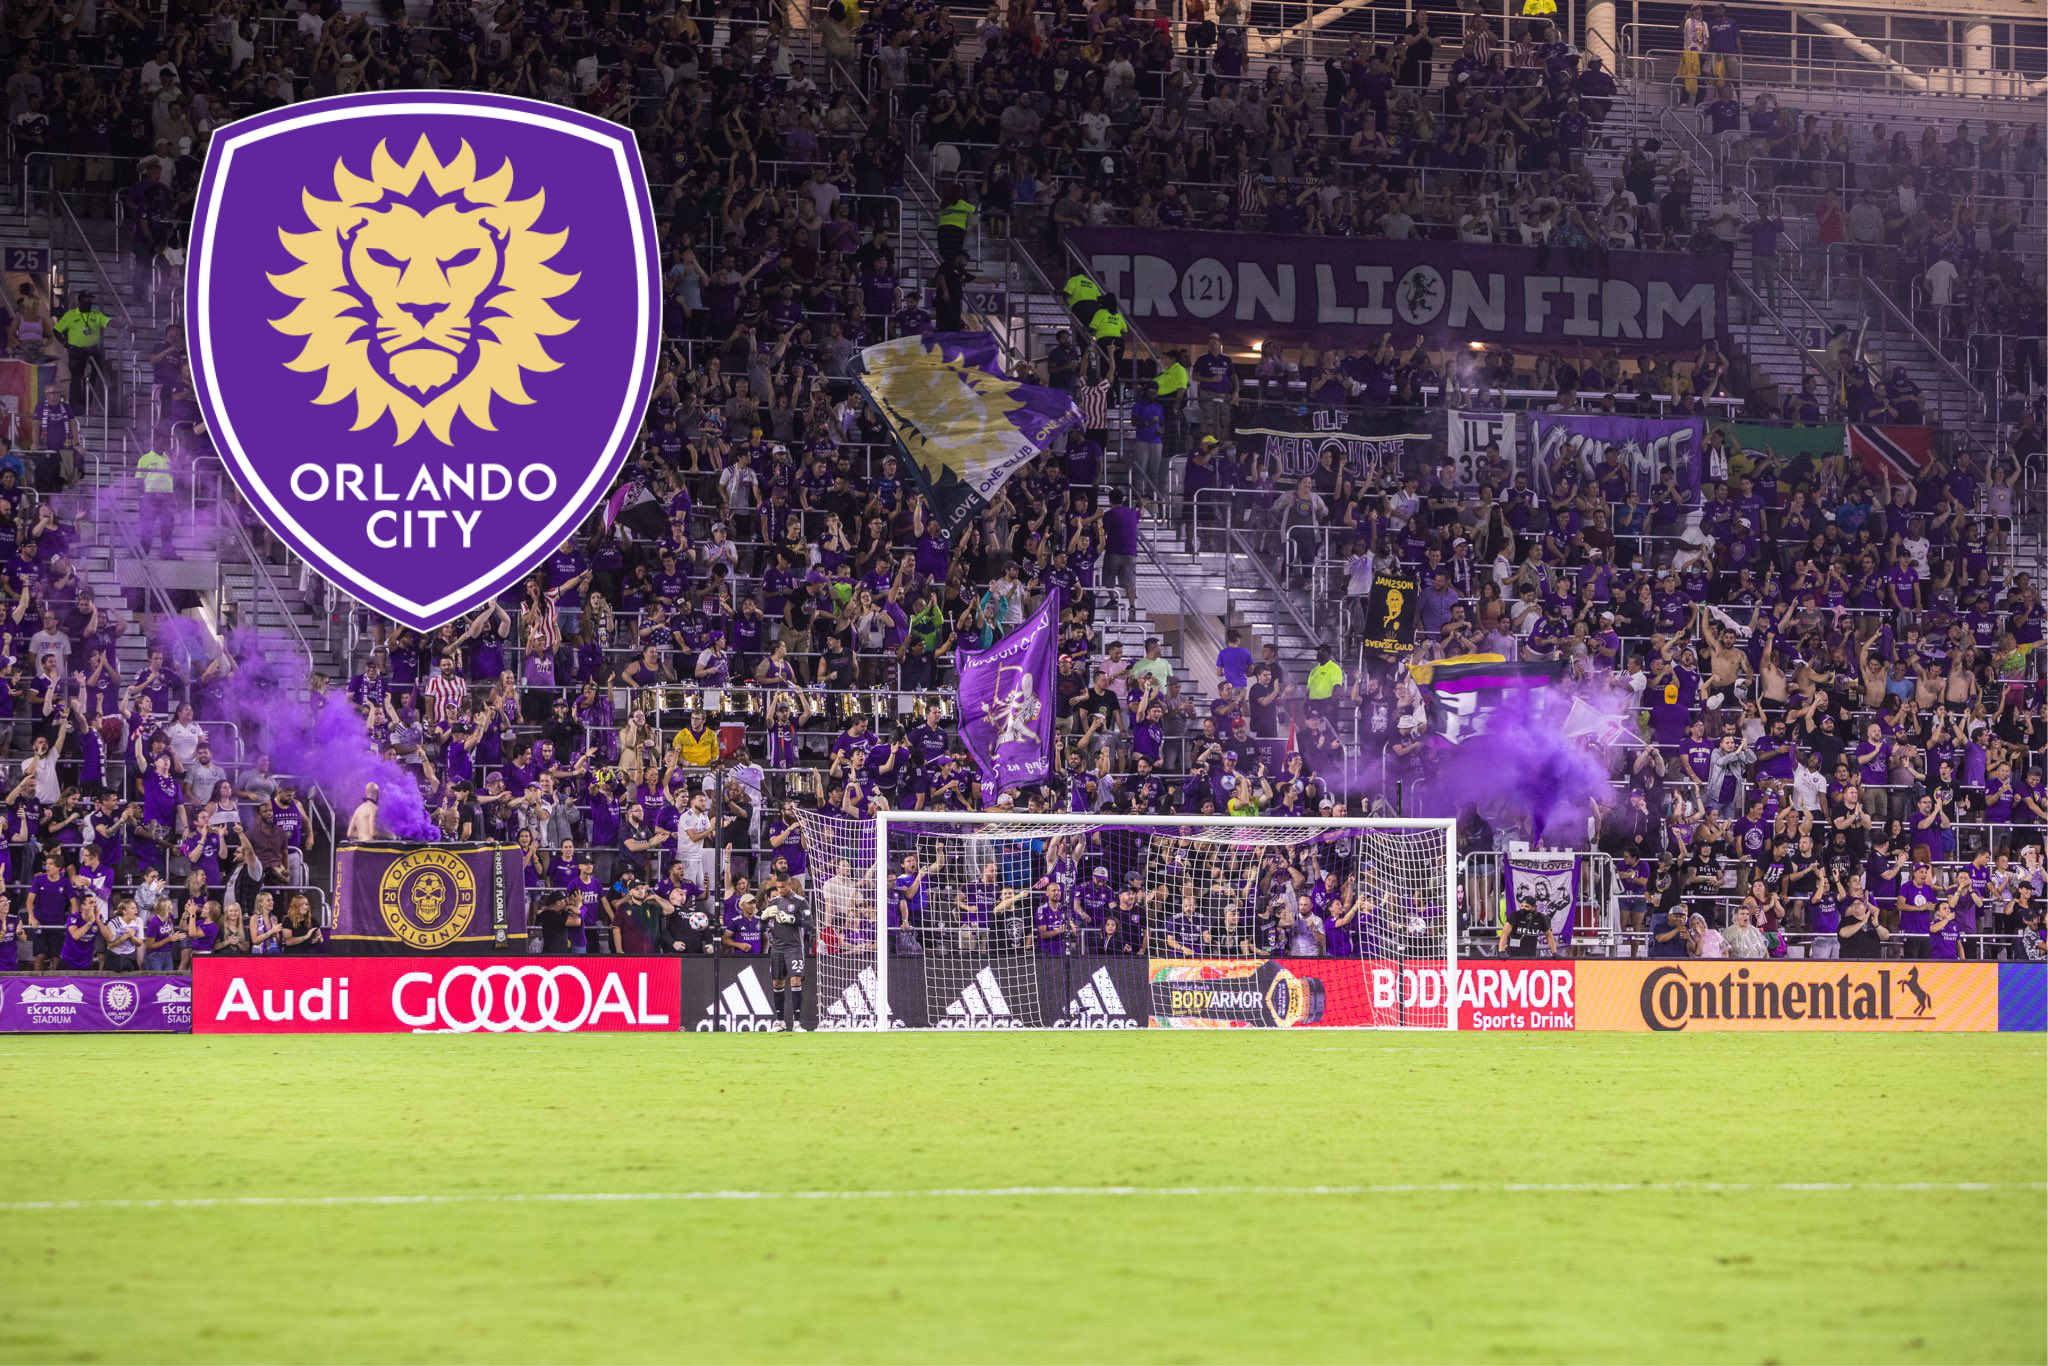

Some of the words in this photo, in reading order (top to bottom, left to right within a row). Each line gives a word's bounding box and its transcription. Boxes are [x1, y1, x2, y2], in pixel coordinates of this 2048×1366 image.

[14, 250, 38, 270] 25
[1091, 254, 1295, 323] IRON
[1315, 264, 1506, 332] LION
[1523, 275, 1716, 340] FIRM
[1187, 273, 1226, 303] 121
[975, 294, 997, 313] 26
[1036, 419, 1059, 442] ONE
[1312, 410, 1349, 431] ILF
[1463, 420, 1503, 452] ILF
[980, 468, 1004, 493] ONE
[1003, 445, 1033, 469] CLUB
[950, 493, 980, 525] LOVE
[1364, 639, 1393, 649] SVENSK
[1394, 643, 1414, 652] GULD
[393, 853, 465, 880] ORLANDO
[1509, 860, 1539, 869] JESUS
[1541, 862, 1573, 870] LOVES
[495, 876, 503, 888] OF
[384, 892, 396, 901] 20
[461, 892, 471, 901] 10
[496, 889, 504, 923] FLORIDA
[391, 913, 467, 944] ORIGINAL
[791, 960, 804, 970] 23
[215, 977, 348, 1021] Audi
[392, 965, 669, 1032] GOOOOAL
[1172, 991, 1263, 1009] BODYARMOR
[1639, 964, 1893, 1032] Continental
[27, 1004, 76, 1015] EXPLORIA
[32, 1015, 72, 1024] STADIUM
[696, 1014, 778, 1032] adida
[819, 1014, 906, 1031] adids
[936, 1014, 1023, 1029] adidas
[1473, 1011, 1525, 1031] Sports
[1530, 1011, 1574, 1028] Drink
